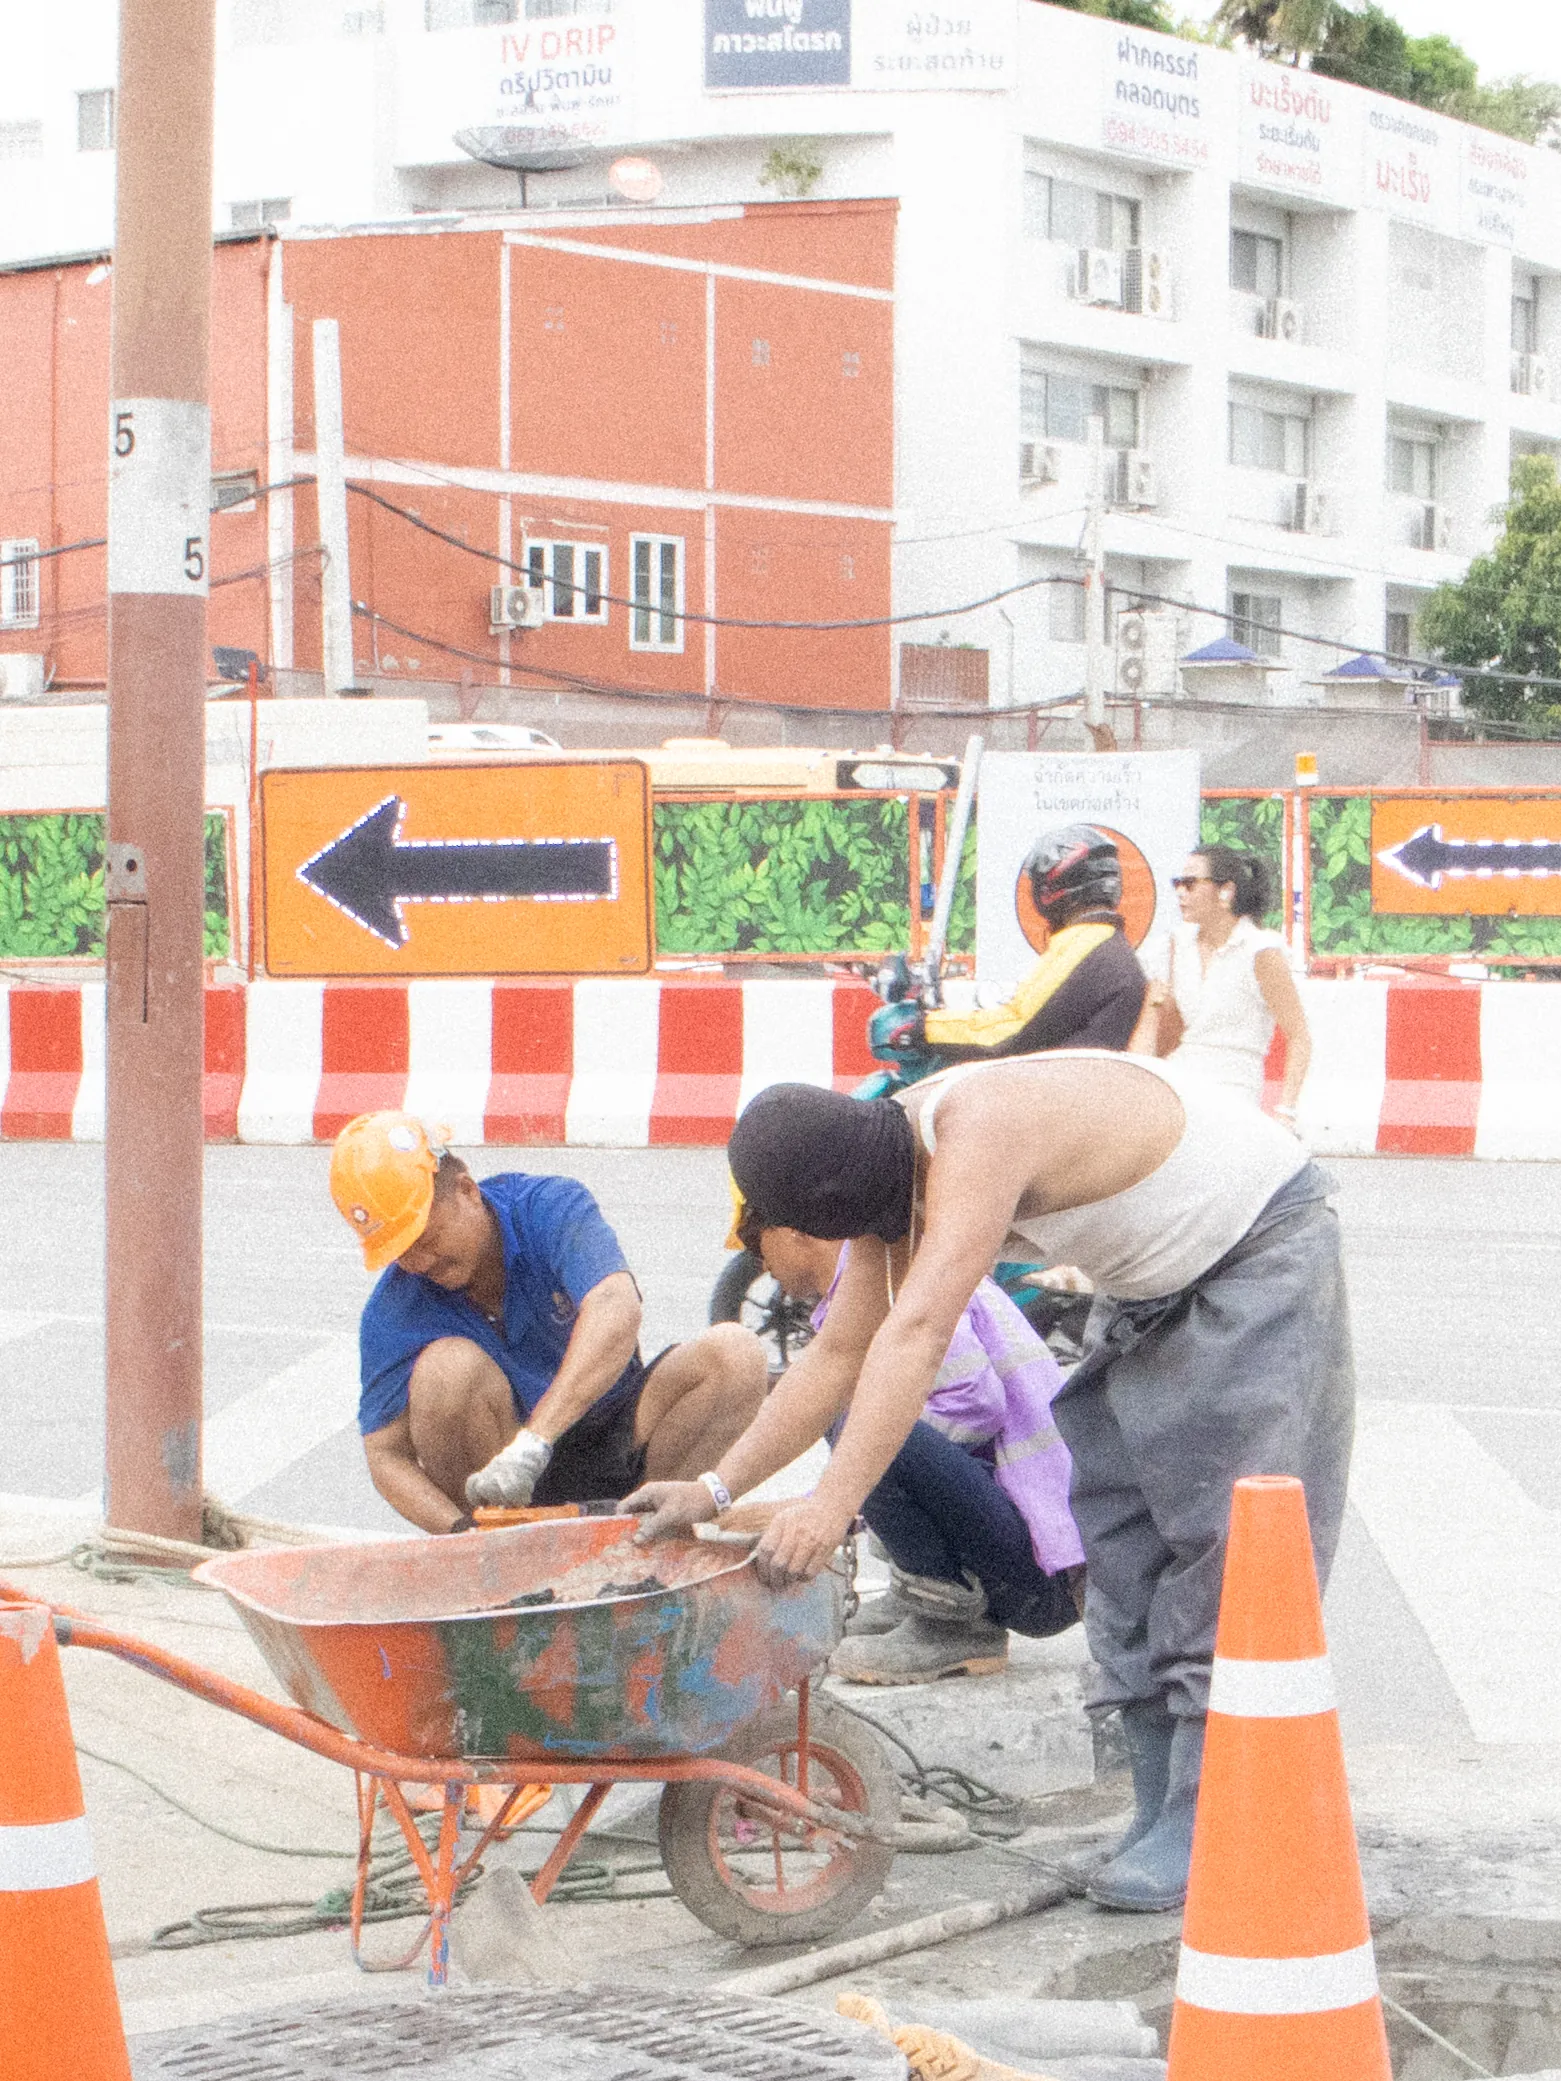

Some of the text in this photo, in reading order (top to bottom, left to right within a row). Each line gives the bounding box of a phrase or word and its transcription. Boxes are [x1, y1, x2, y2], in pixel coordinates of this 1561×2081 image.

[500, 23, 617, 64] IV DRIP
[1116, 36, 1200, 81] ฝากครรภ์
[1114, 78, 1201, 121] คลอดบุตร
[1250, 74, 1332, 125] มะเร็งตับ
[1375, 151, 1432, 205] มะเร็ง
[114, 411, 135, 458] 5
[184, 536, 204, 581] 5
